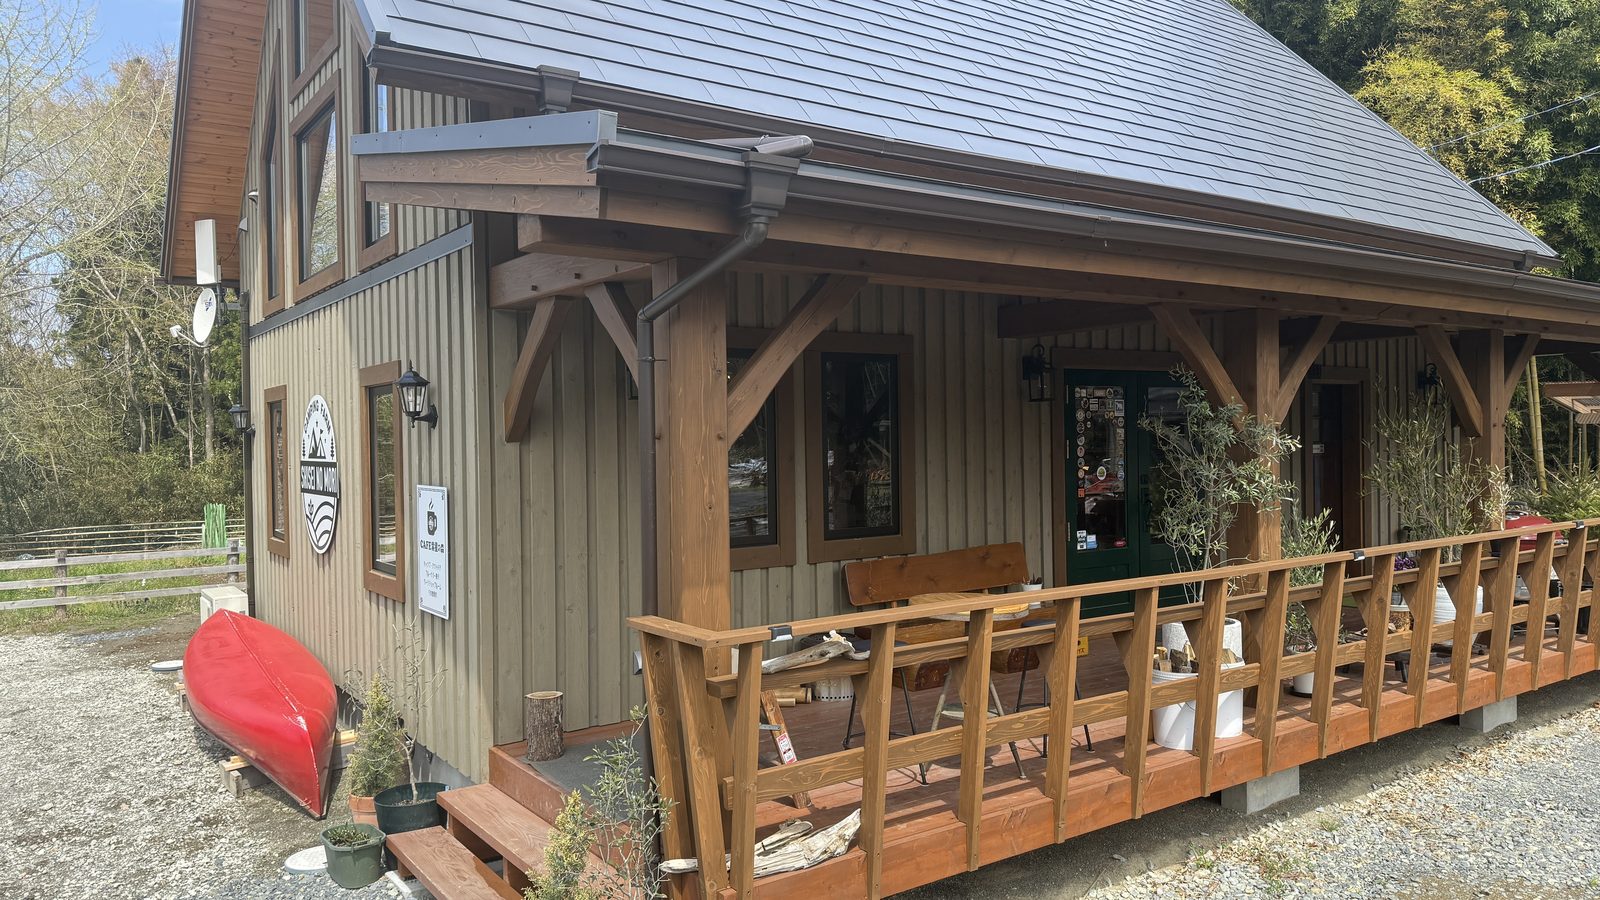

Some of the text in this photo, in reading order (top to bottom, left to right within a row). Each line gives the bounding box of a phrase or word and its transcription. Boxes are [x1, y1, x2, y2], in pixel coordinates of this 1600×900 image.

[303, 399, 332, 434] CAMPING FARM
[316, 466, 323, 491] NO
[323, 466, 337, 493] MORI
